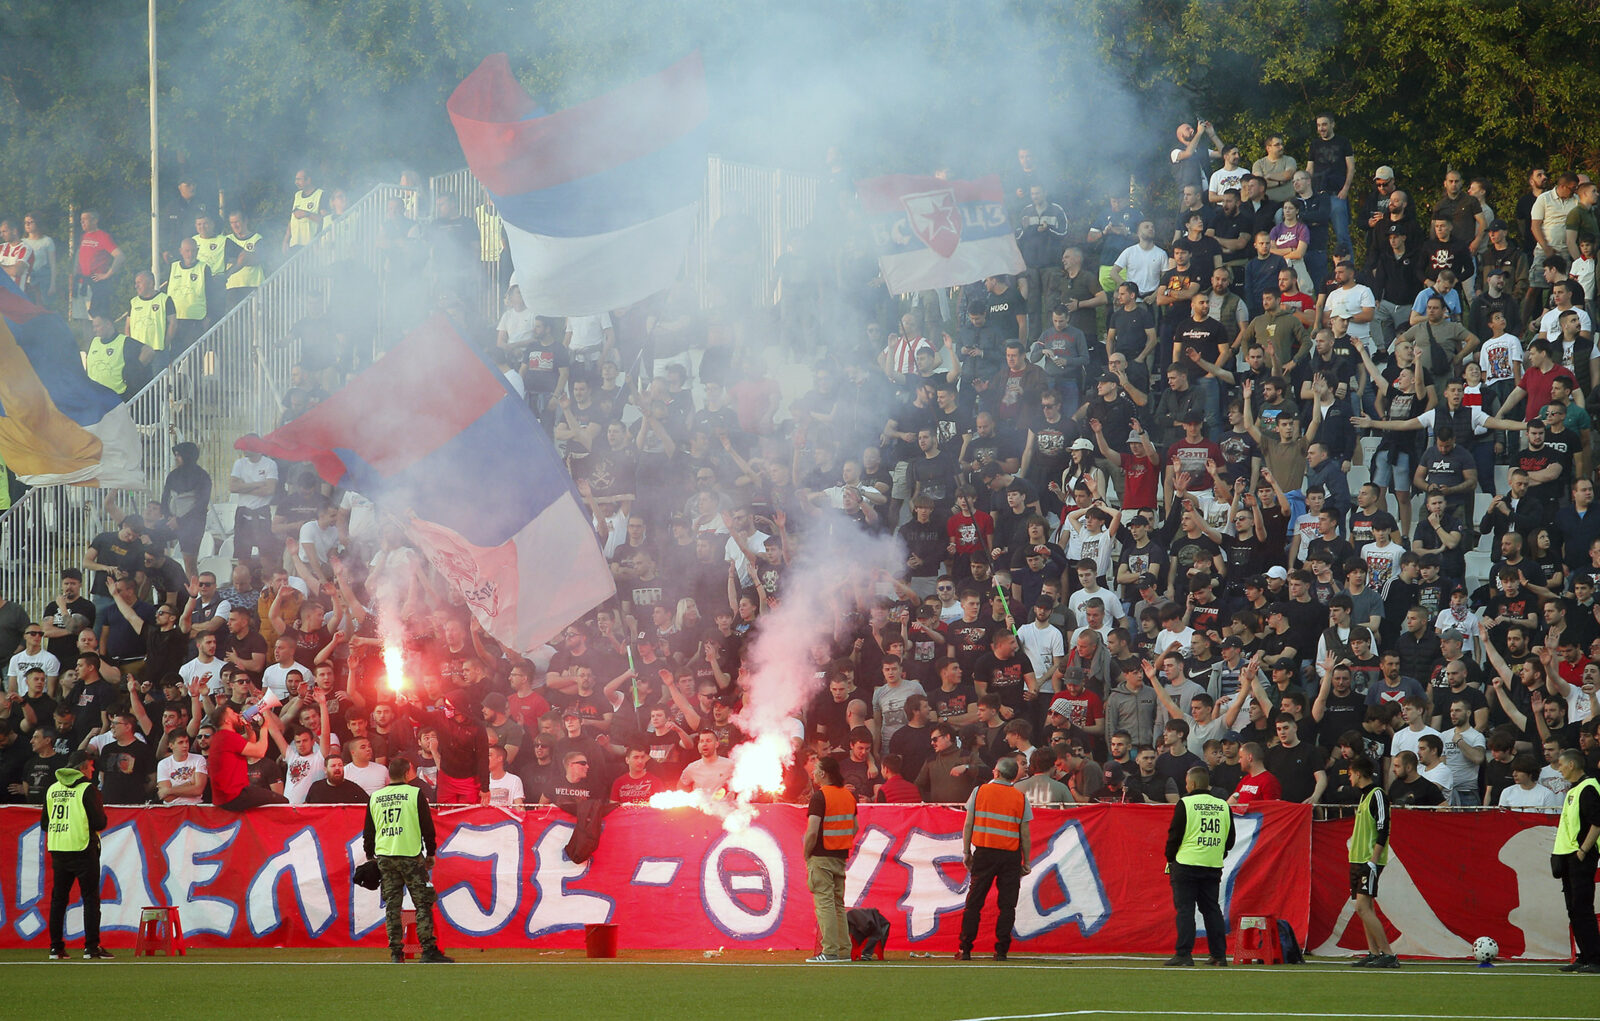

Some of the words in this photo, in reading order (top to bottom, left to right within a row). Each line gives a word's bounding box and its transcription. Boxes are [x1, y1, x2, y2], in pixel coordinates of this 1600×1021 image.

[990, 303, 1009, 313] HUGO
[555, 787, 590, 797] WELCOME
[51, 804, 69, 819] 791
[383, 808, 401, 824] 157
[49, 823, 69, 832] РЕДАР
[1200, 817, 1220, 833] 546
[381, 826, 403, 837] РЕДАР
[1197, 836, 1221, 846] РЕДАР
